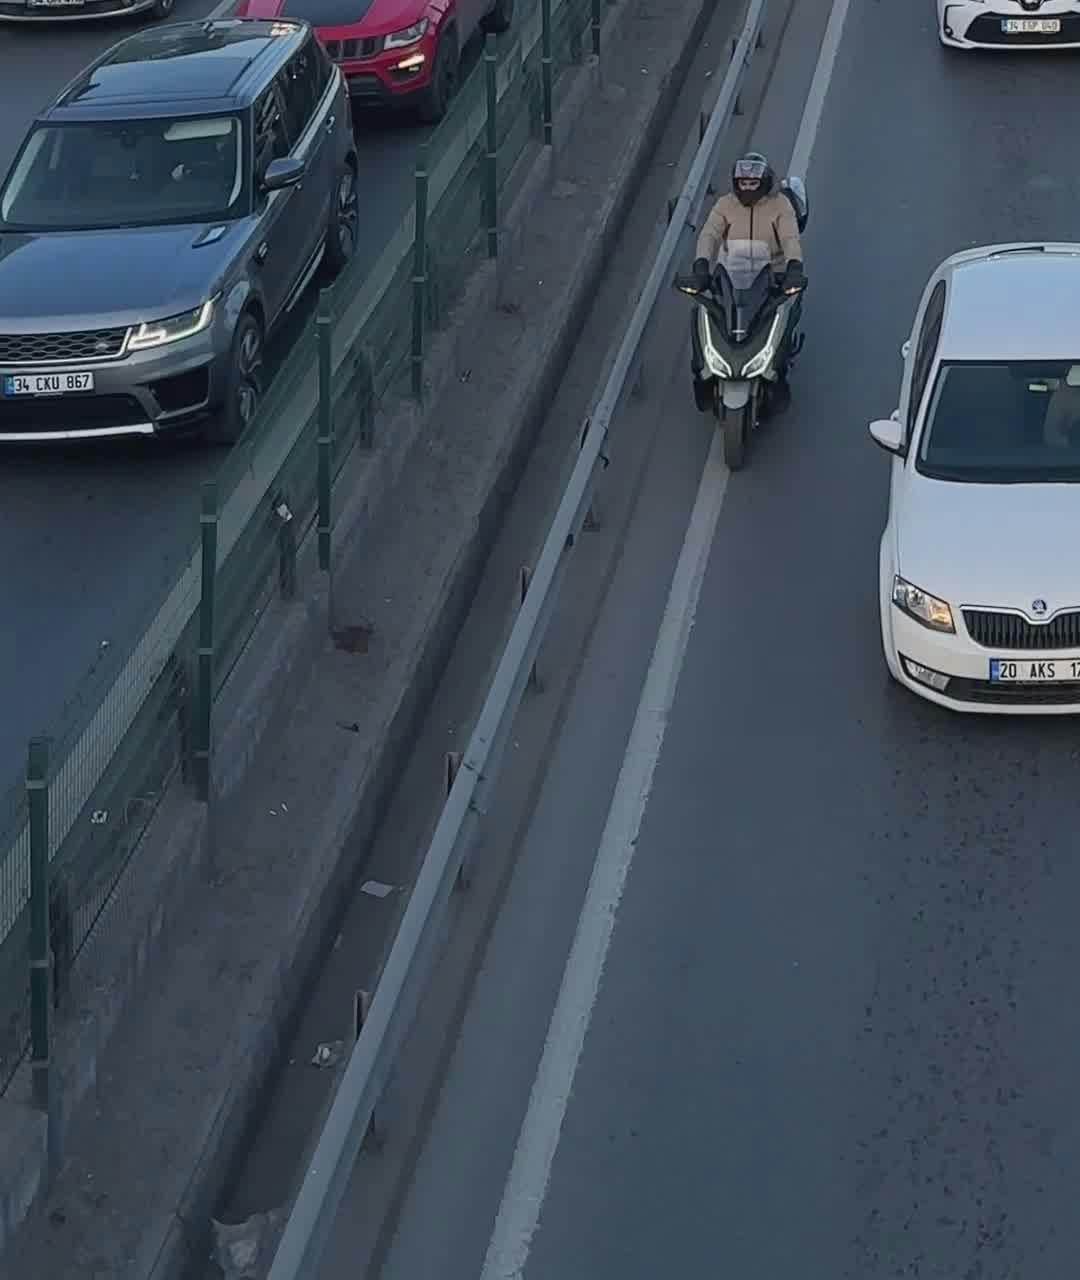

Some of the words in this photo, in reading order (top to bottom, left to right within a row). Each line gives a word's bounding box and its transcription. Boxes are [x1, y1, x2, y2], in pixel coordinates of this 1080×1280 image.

[15, 378, 29, 392] 34
[36, 376, 60, 391] CKU
[66, 374, 90, 389] 867
[1000, 663, 1017, 679] 20
[1030, 663, 1055, 679] AKS
